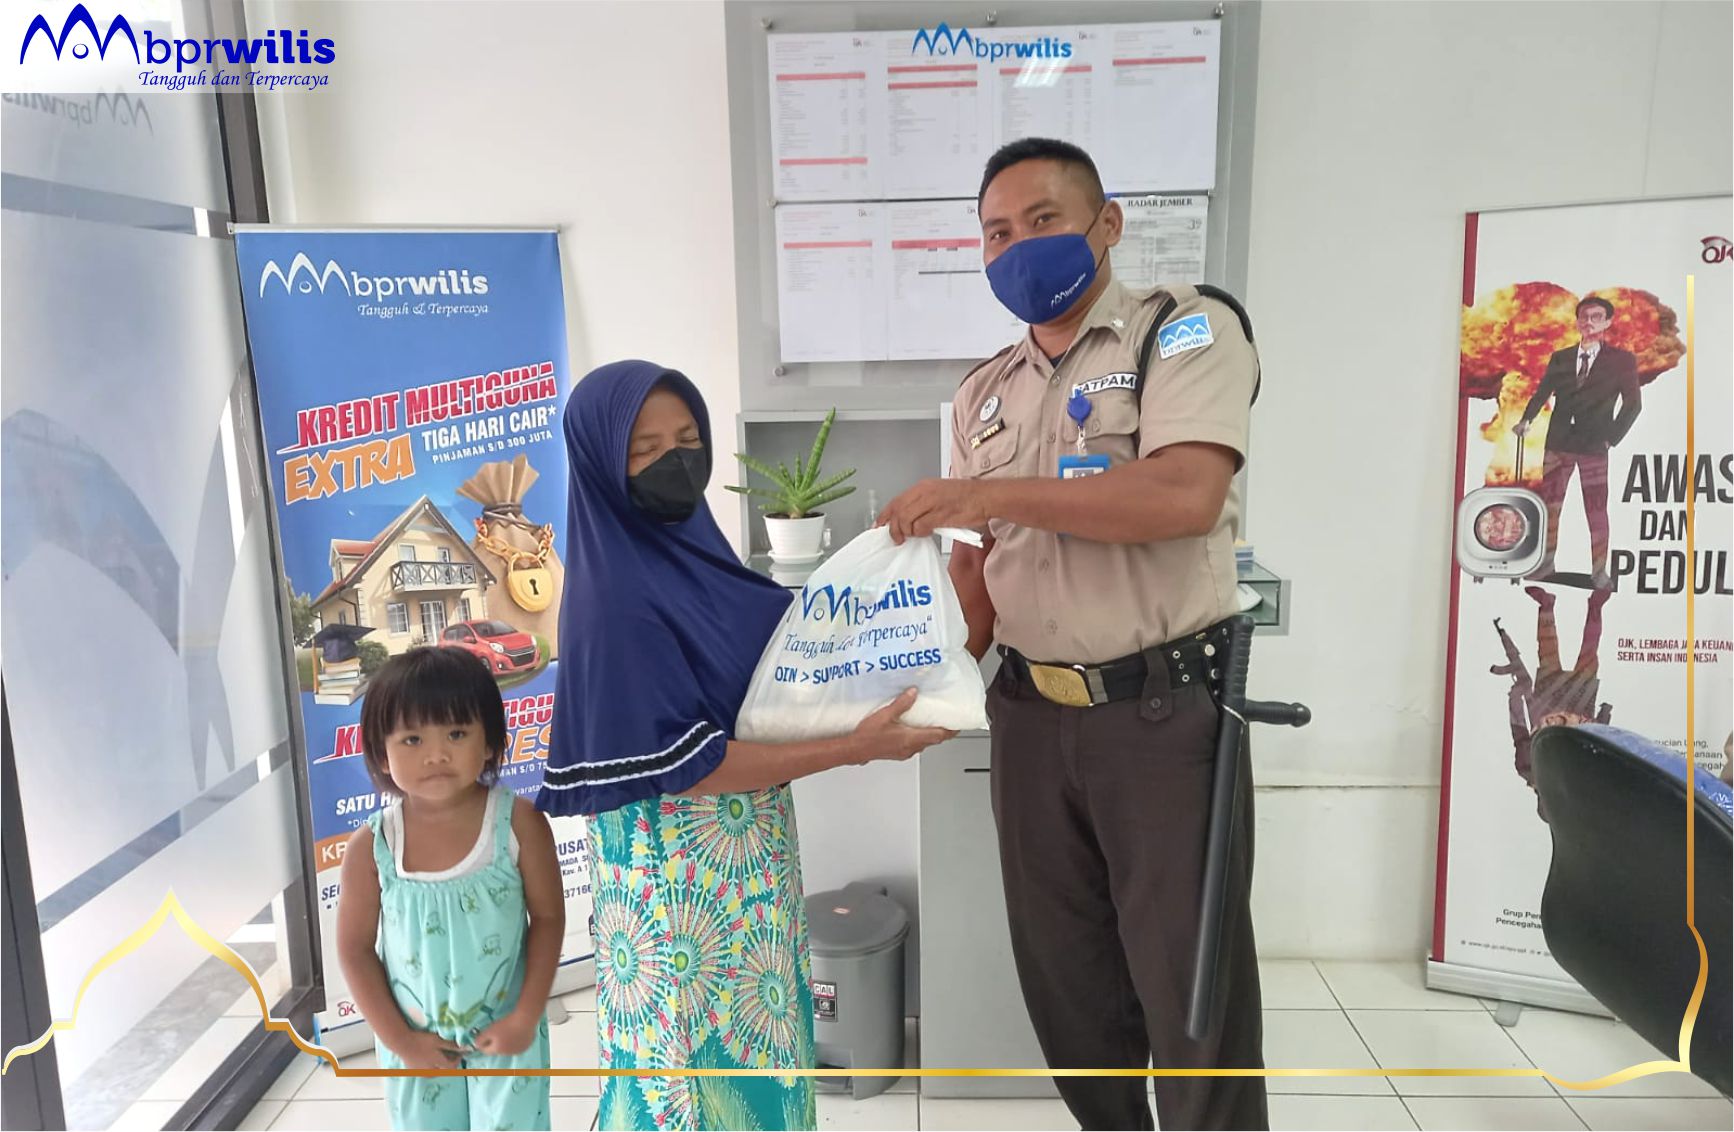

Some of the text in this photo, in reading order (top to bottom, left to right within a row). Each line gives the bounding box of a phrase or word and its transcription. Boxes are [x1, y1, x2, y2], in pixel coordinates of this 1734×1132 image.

[975, 37, 1073, 62] bprwilis
[351, 270, 489, 302] bprwilis
[358, 301, 489, 319] Tangguh & Terpercaya
[1079, 375, 1134, 392] ATPAM
[297, 361, 558, 448] KREDIT MULTIGUNA
[421, 425, 461, 451] TIGA
[465, 415, 505, 442] HARI
[432, 430, 553, 465] PINJAMAN S/D 300 JUTA
[283, 433, 416, 505] EXTRA
[1640, 639, 1679, 650] LEMBAGA
[1701, 640, 1734, 652] KEUAN
[879, 648, 942, 671] SUCCESS
[1617, 651, 1718, 664] SERTA INSAN INDNESIA
[336, 793, 376, 816] SATU
[1503, 908, 1524, 919] Grup
